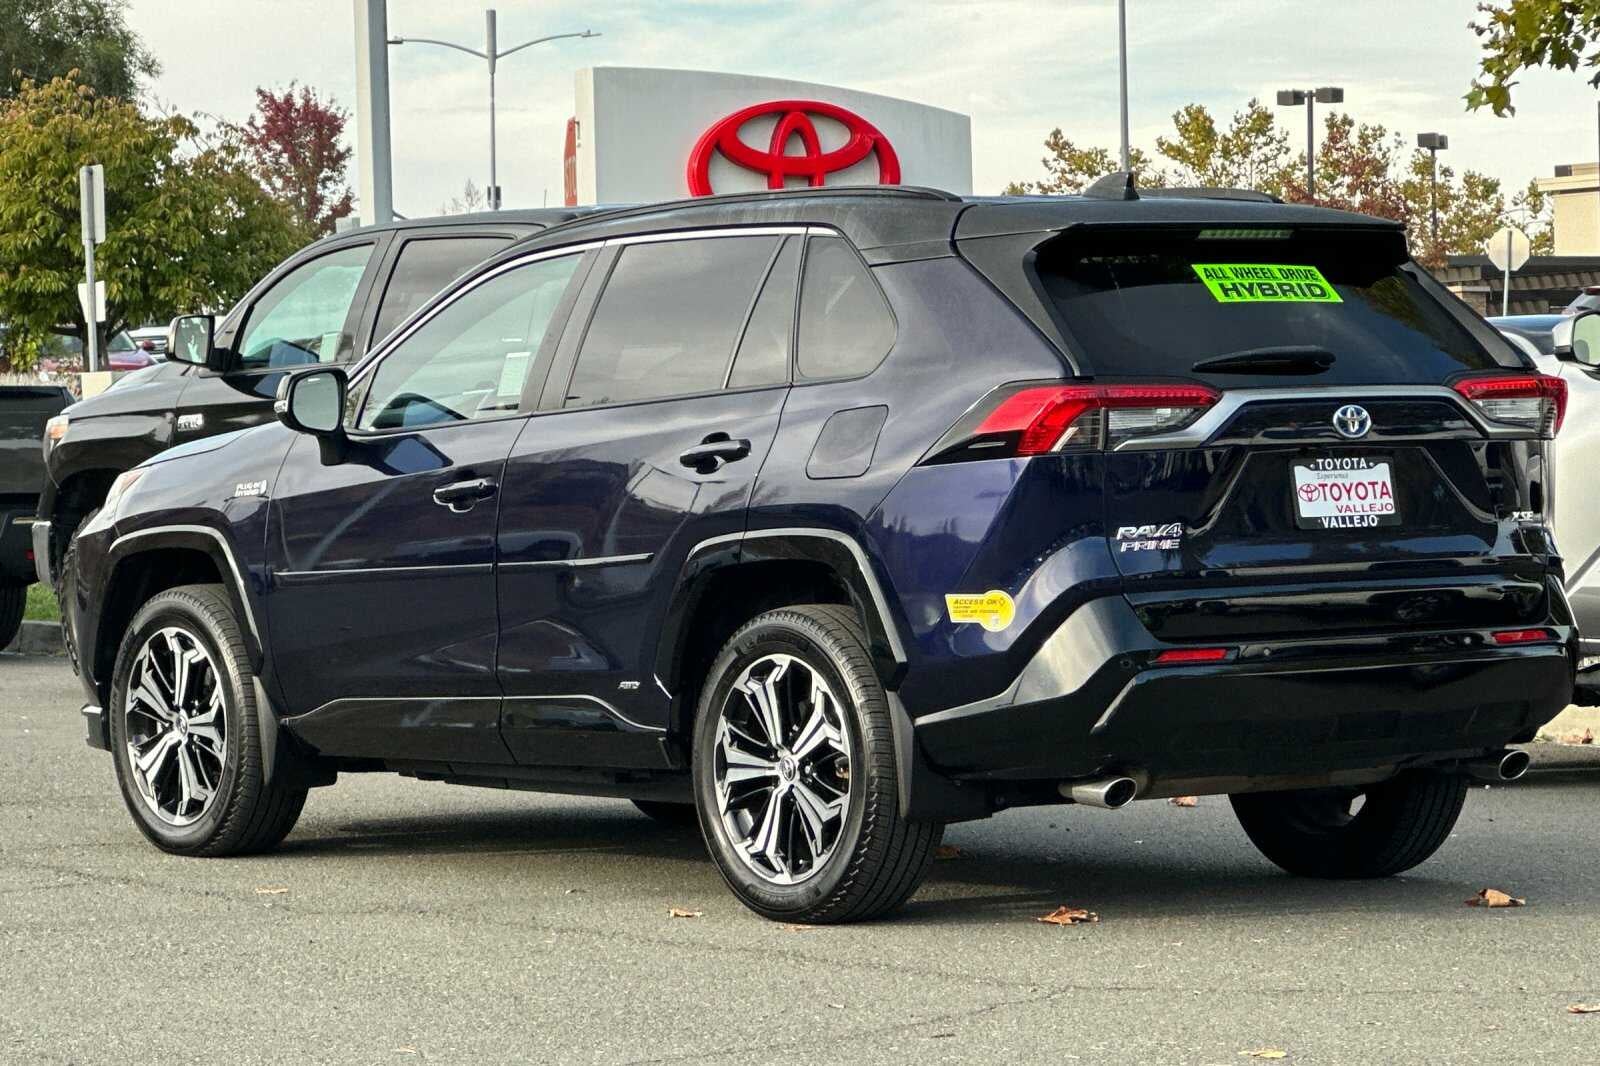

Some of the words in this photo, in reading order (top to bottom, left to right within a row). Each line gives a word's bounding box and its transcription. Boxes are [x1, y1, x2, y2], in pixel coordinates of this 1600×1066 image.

[1202, 267, 1229, 280] ALL
[1229, 267, 1279, 280] WHEEL
[1279, 268, 1320, 281] DRIVE
[1218, 282, 1330, 298] HYBRID
[1316, 458, 1367, 470] TOYOTA
[1318, 481, 1392, 502] TOYOTA
[1336, 502, 1394, 514] VALLEJO
[1321, 515, 1378, 528] VALLEJO
[1511, 511, 1534, 521] XSE
[1116, 522, 1182, 540] RAV4
[1120, 539, 1181, 552] PRIME
